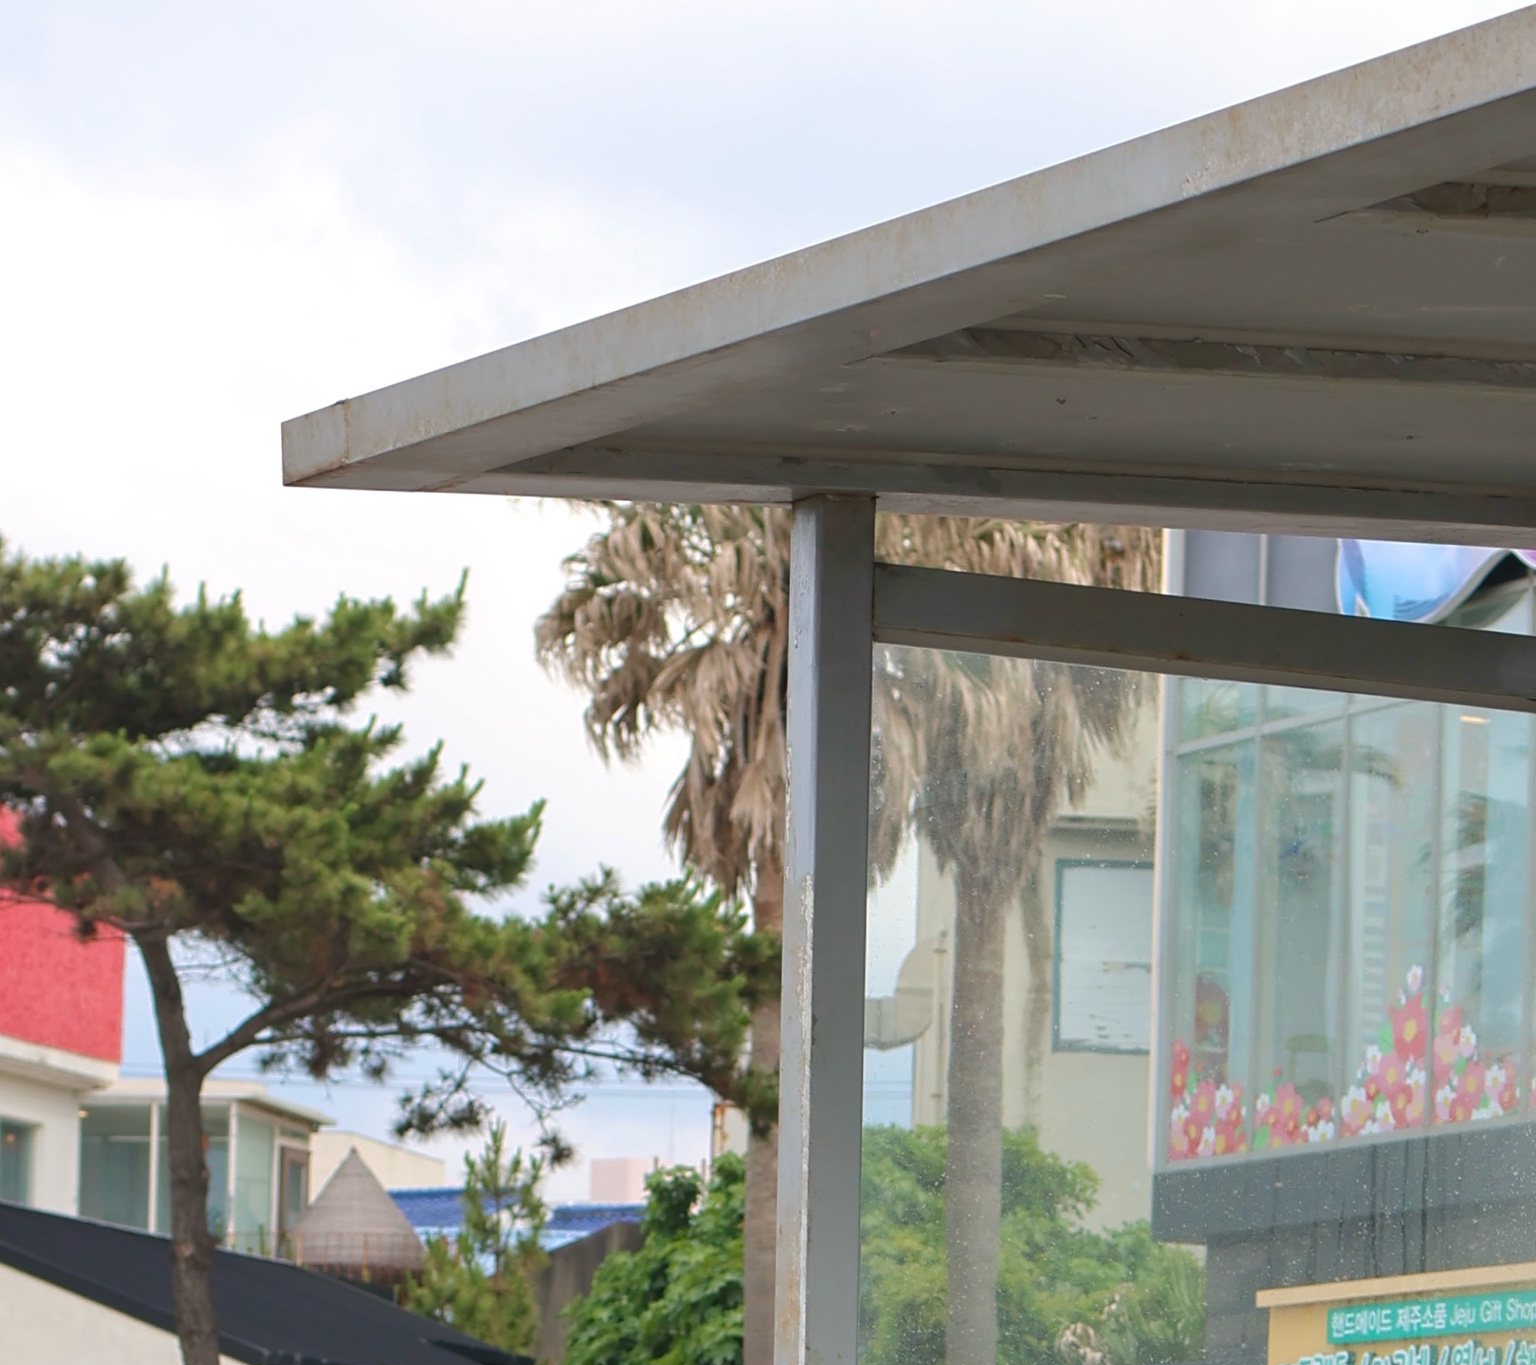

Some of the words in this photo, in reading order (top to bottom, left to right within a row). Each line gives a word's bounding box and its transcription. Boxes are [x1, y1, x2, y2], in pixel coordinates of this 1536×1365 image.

[1331, 1309, 1392, 1338] 핸드메이드
[1396, 1303, 1447, 1331] 제주소품
[1451, 1303, 1476, 1327] Jeju
[1480, 1300, 1503, 1323] Gift
